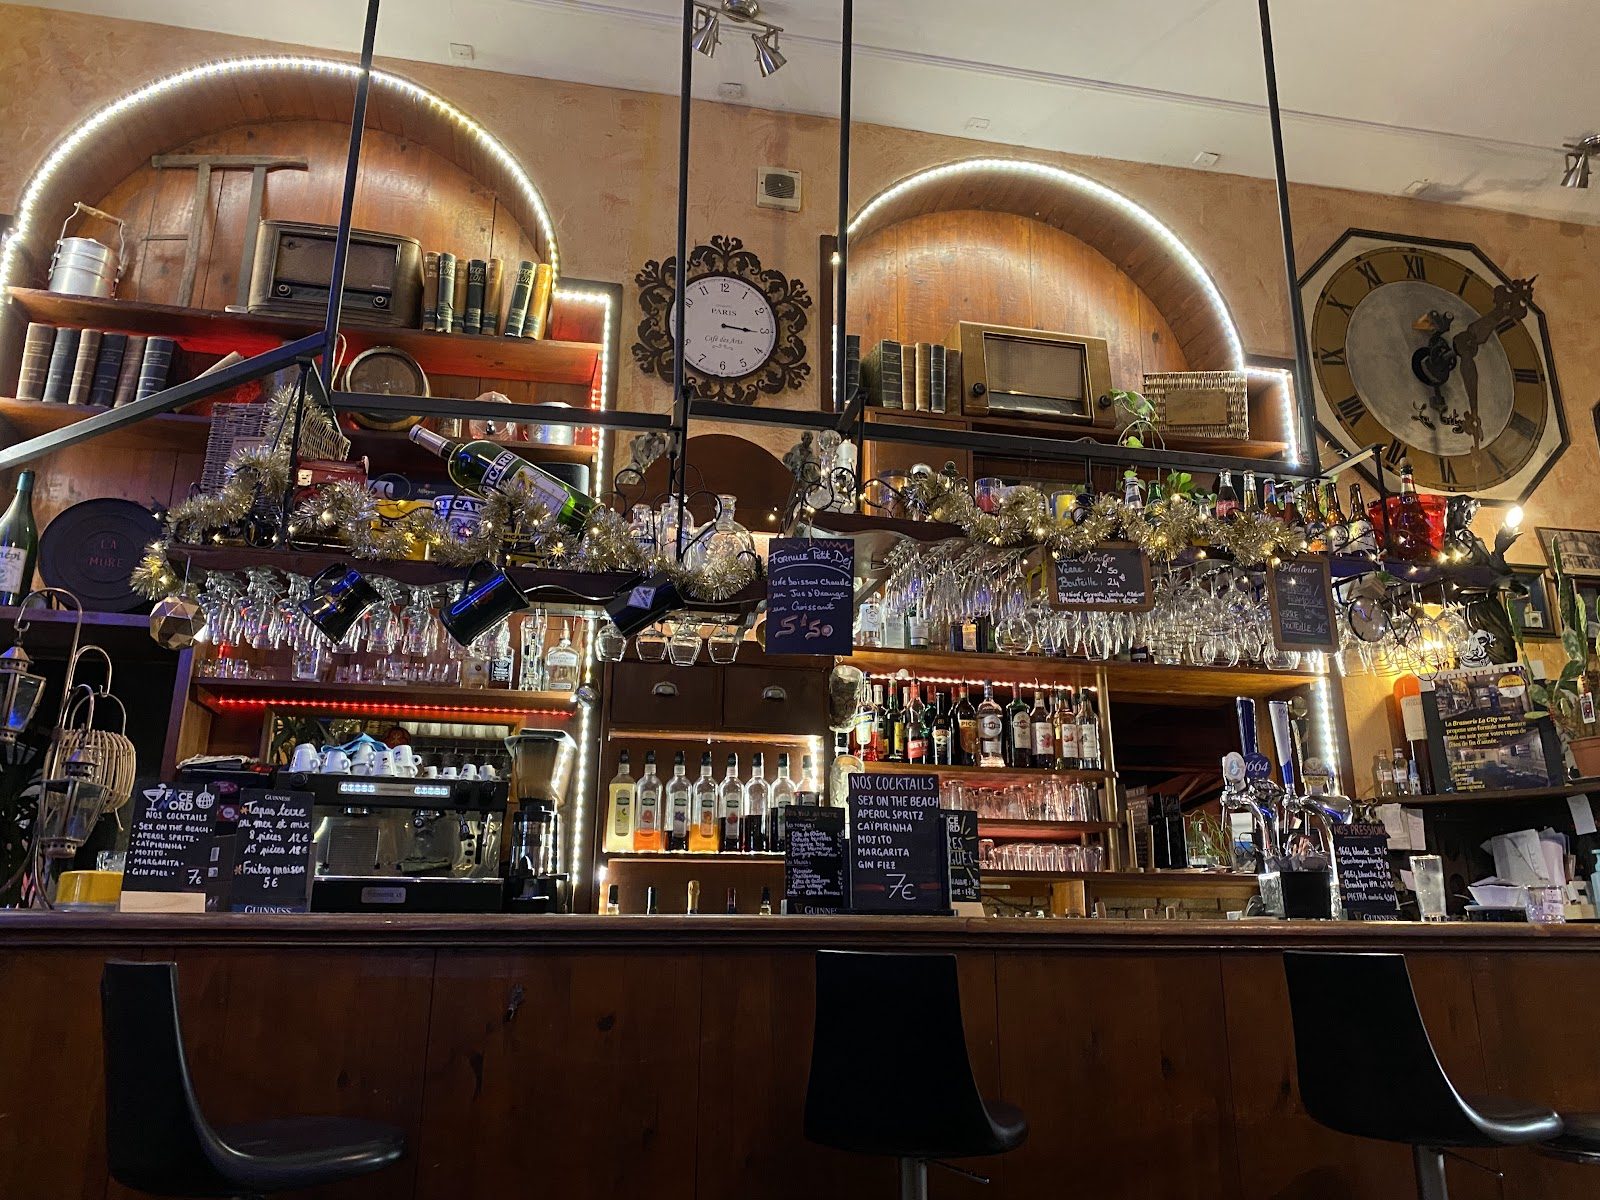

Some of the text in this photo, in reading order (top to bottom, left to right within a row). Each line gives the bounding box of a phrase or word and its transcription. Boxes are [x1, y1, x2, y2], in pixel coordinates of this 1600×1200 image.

[699, 285, 709, 296] 11
[720, 283, 730, 293] 12
[741, 291, 748, 300] 1
[711, 308, 737, 317] PARIS
[754, 307, 765, 316] 2
[760, 327, 770, 335] 3
[753, 347, 763, 355] 4
[698, 353, 707, 363] 7
[739, 358, 748, 367] 5
[719, 361, 726, 371] 6
[482, 451, 515, 493] RICARD
[435, 499, 483, 511] RICAR
[503, 533, 531, 541] RICARD
[1280, 562, 1318, 574] Planteur
[1245, 760, 1269, 772] 1664
[851, 776, 934, 791] NOS COCKTAILS
[165, 791, 193, 801] FACE
[857, 795, 938, 808] SEX ON THE BEACH
[244, 801, 306, 818] Tapas terre
[145, 811, 207, 821] NOS COCKTAILS
[857, 809, 924, 821] APEROL SPRITZ
[139, 822, 153, 830] SEX
[857, 822, 913, 833] CAÏPIRINHA
[249, 831, 255, 840] 8
[857, 835, 892, 845] MOJITO
[857, 847, 910, 857] MARGARITA
[134, 858, 179, 867] MARGARITA
[857, 860, 896, 870] GIN FIZZ
[132, 868, 149, 876] GIN
[886, 873, 917, 900] 7€
[244, 904, 292, 914] GUINNESS
